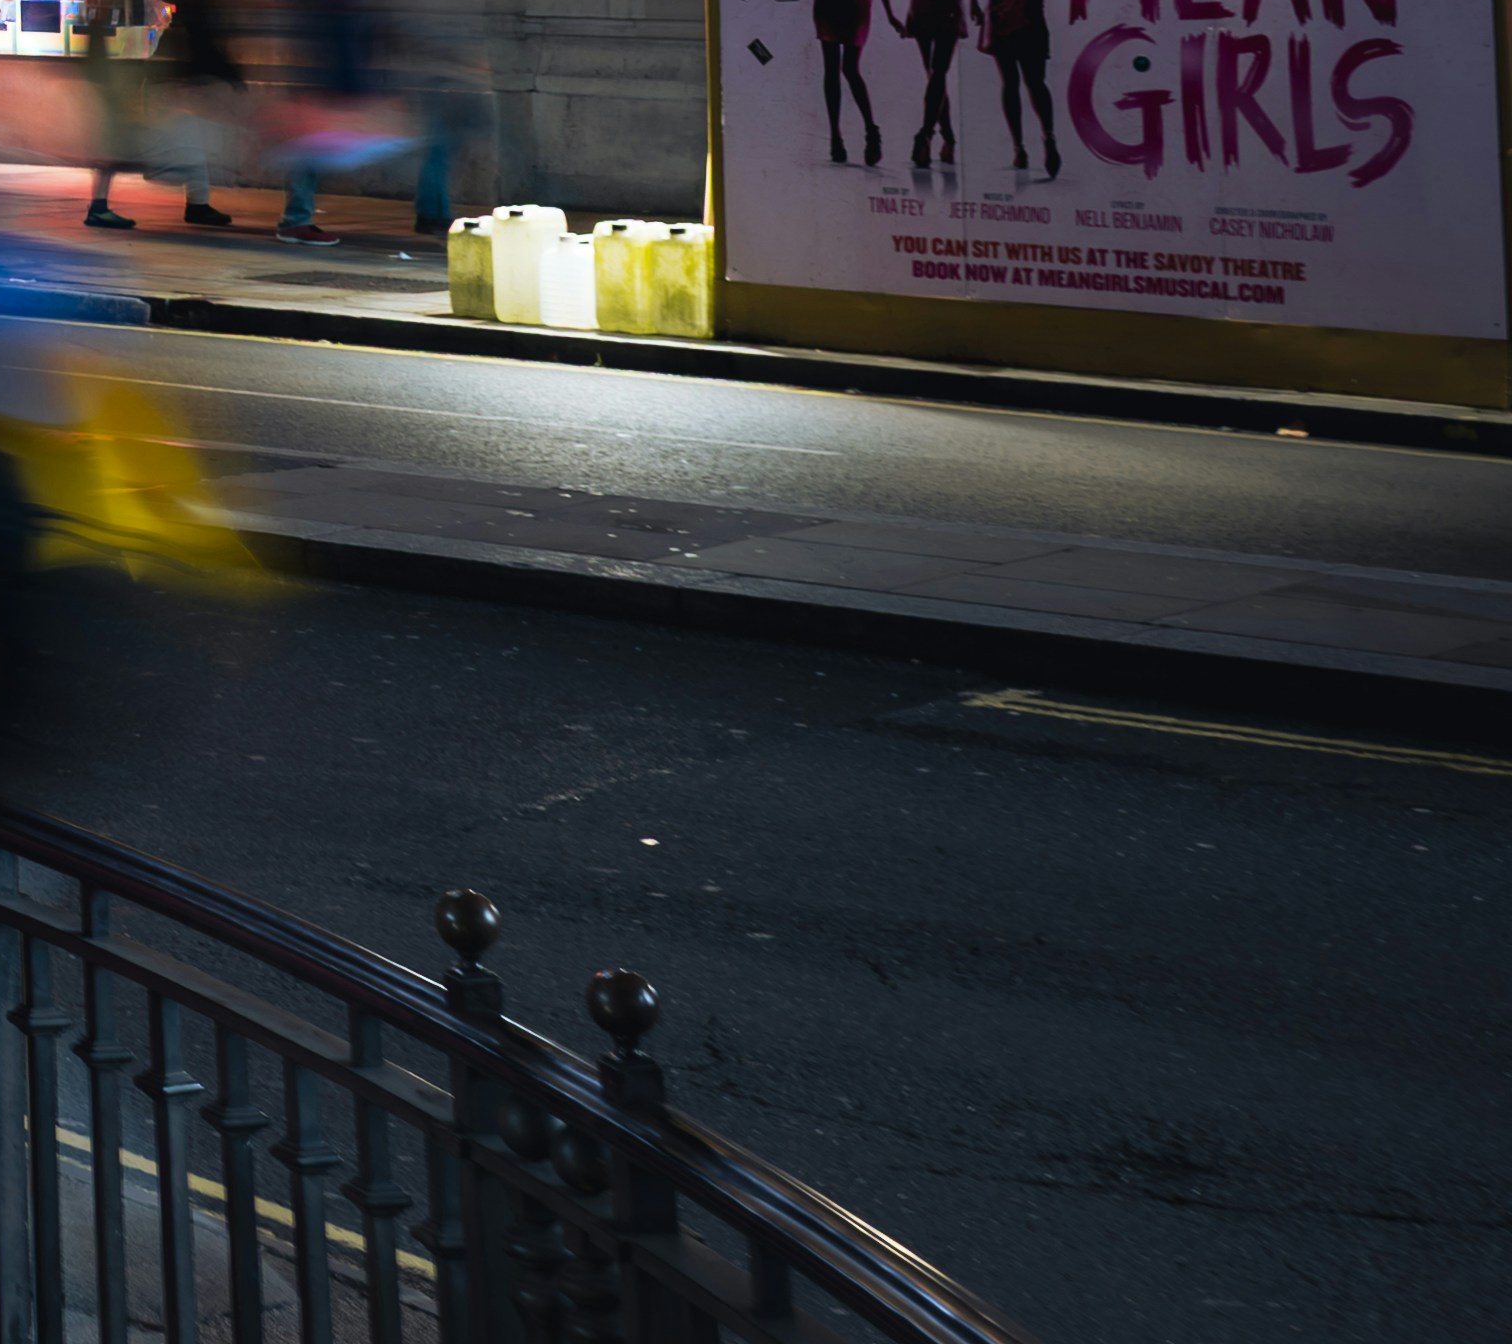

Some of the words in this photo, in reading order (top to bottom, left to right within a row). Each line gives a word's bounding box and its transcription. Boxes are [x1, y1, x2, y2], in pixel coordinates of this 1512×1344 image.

[1066, 23, 1415, 189] GIRLS
[868, 196, 898, 214] TINA
[901, 199, 925, 216] FEY
[948, 202, 978, 219] JEFF
[980, 205, 1051, 225] RICHMOND
[1075, 209, 1110, 229] NELL
[1112, 212, 1183, 233] BENJAMIN
[1208, 217, 1255, 238] CASEY
[1258, 221, 1334, 243] NICHOLAW
[891, 234, 927, 255] YOU
[931, 237, 969, 258] CAN
[972, 240, 1001, 259] SIT
[1004, 242, 1053, 263] WITH
[1056, 246, 1082, 265] US
[1085, 247, 1109, 267] AT
[1112, 249, 1149, 270] THE
[1153, 252, 1215, 275] SAVOY
[1218, 257, 1307, 282] THEATRE
[911, 260, 961, 281] BOOK
[964, 263, 1008, 285] NOW
[1010, 267, 1034, 286] AT
[1037, 269, 1286, 305] MEANGIRLSMUSICAL.COM
